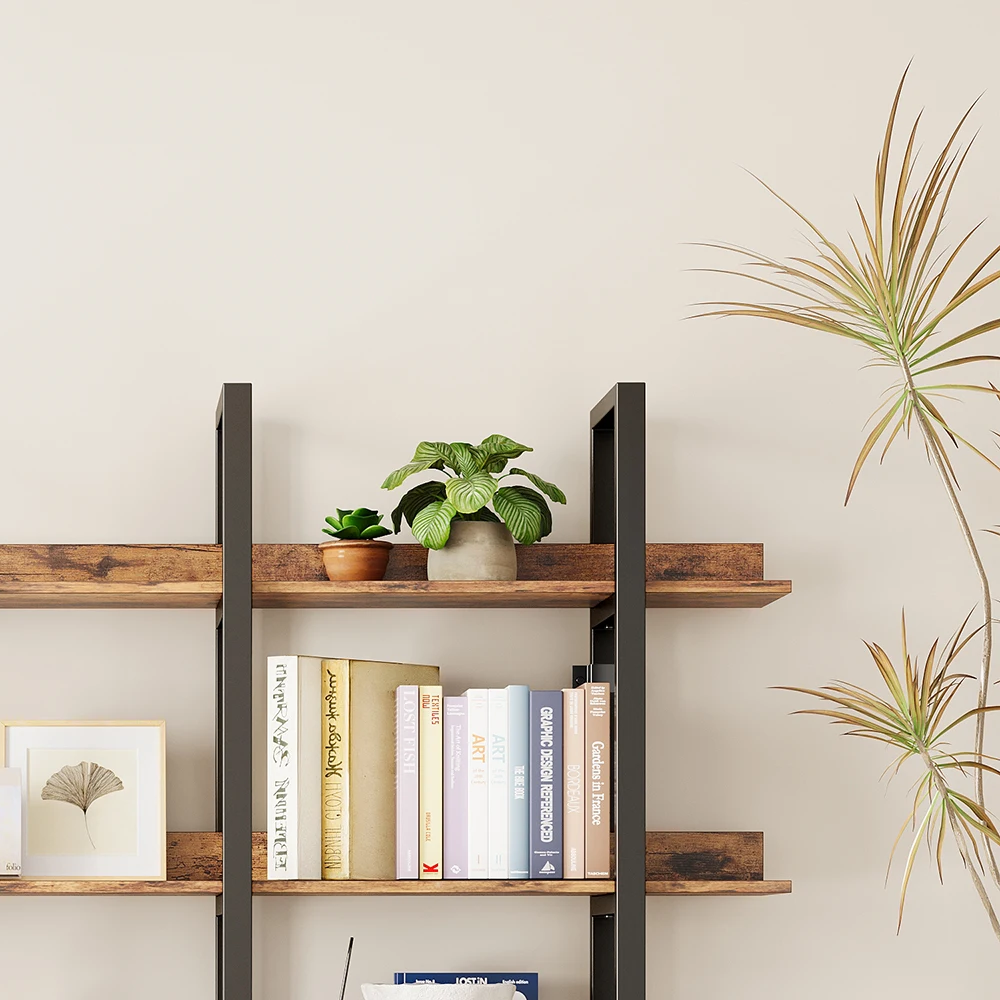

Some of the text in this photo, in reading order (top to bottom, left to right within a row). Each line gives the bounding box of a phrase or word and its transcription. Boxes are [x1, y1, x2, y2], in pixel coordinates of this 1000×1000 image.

[431, 694, 440, 725] TEXTILES
[403, 690, 416, 774] LOST FISH
[454, 725, 462, 734] The
[454, 735, 462, 743] Art
[540, 707, 553, 747] GRAPHIC
[454, 751, 462, 772] Knitting
[472, 733, 486, 763] ART
[492, 733, 505, 763] ART
[540, 749, 553, 782] DESIGN
[514, 765, 524, 800] THE BIKE BOOK
[567, 764, 580, 814] BORDEAUX
[591, 741, 605, 826] Gardens in France
[540, 784, 553, 843] REFERENCED
[6, 863, 21, 871] folio
